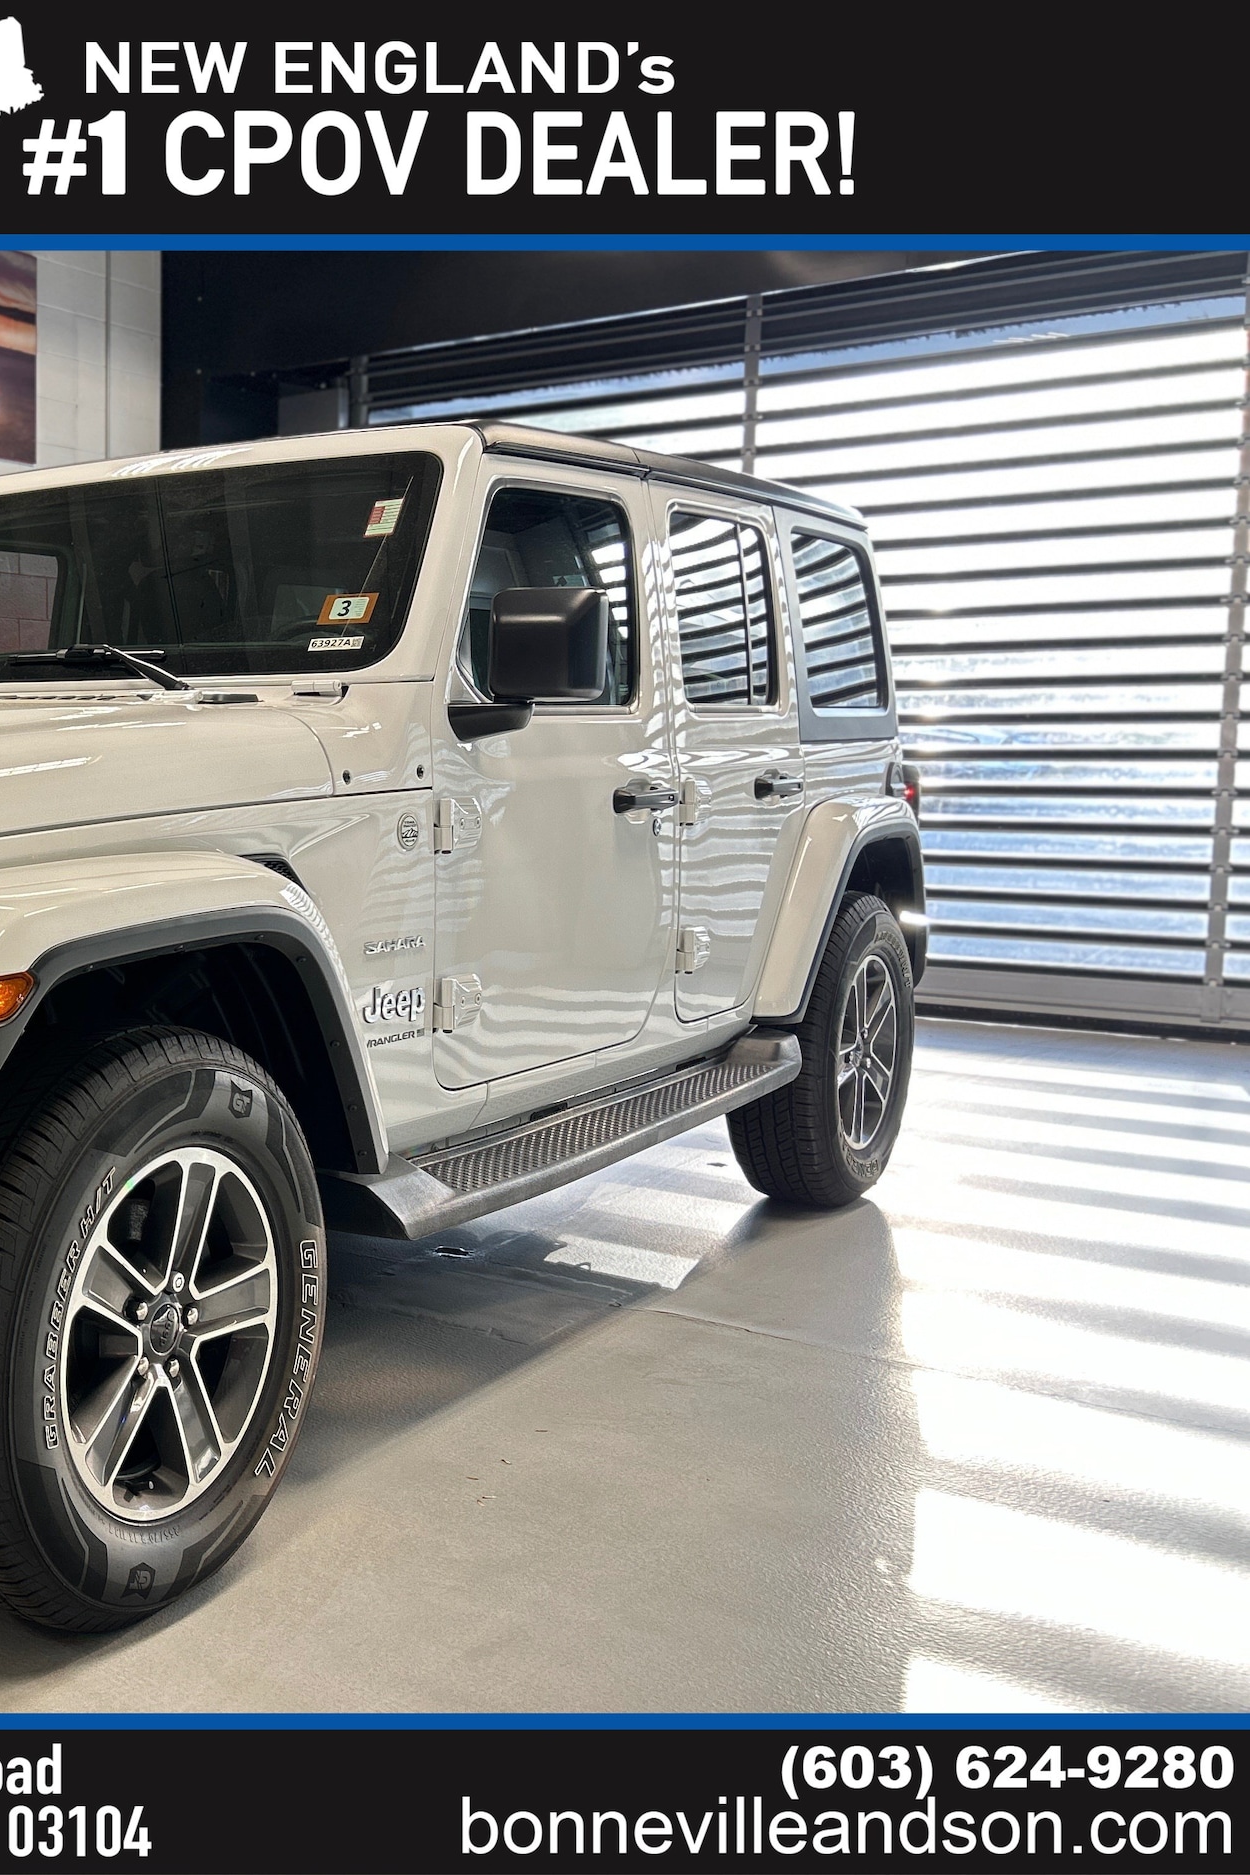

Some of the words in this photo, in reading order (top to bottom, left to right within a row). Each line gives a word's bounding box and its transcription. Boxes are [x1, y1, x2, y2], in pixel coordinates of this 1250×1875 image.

[337, 600, 352, 617] 3
[311, 638, 351, 648] 63927A
[364, 935, 426, 955] SAHARA
[363, 986, 425, 1024] Jeep
[43, 1240, 80, 1450] GRABBER
[254, 1239, 318, 1477] GENERAL
